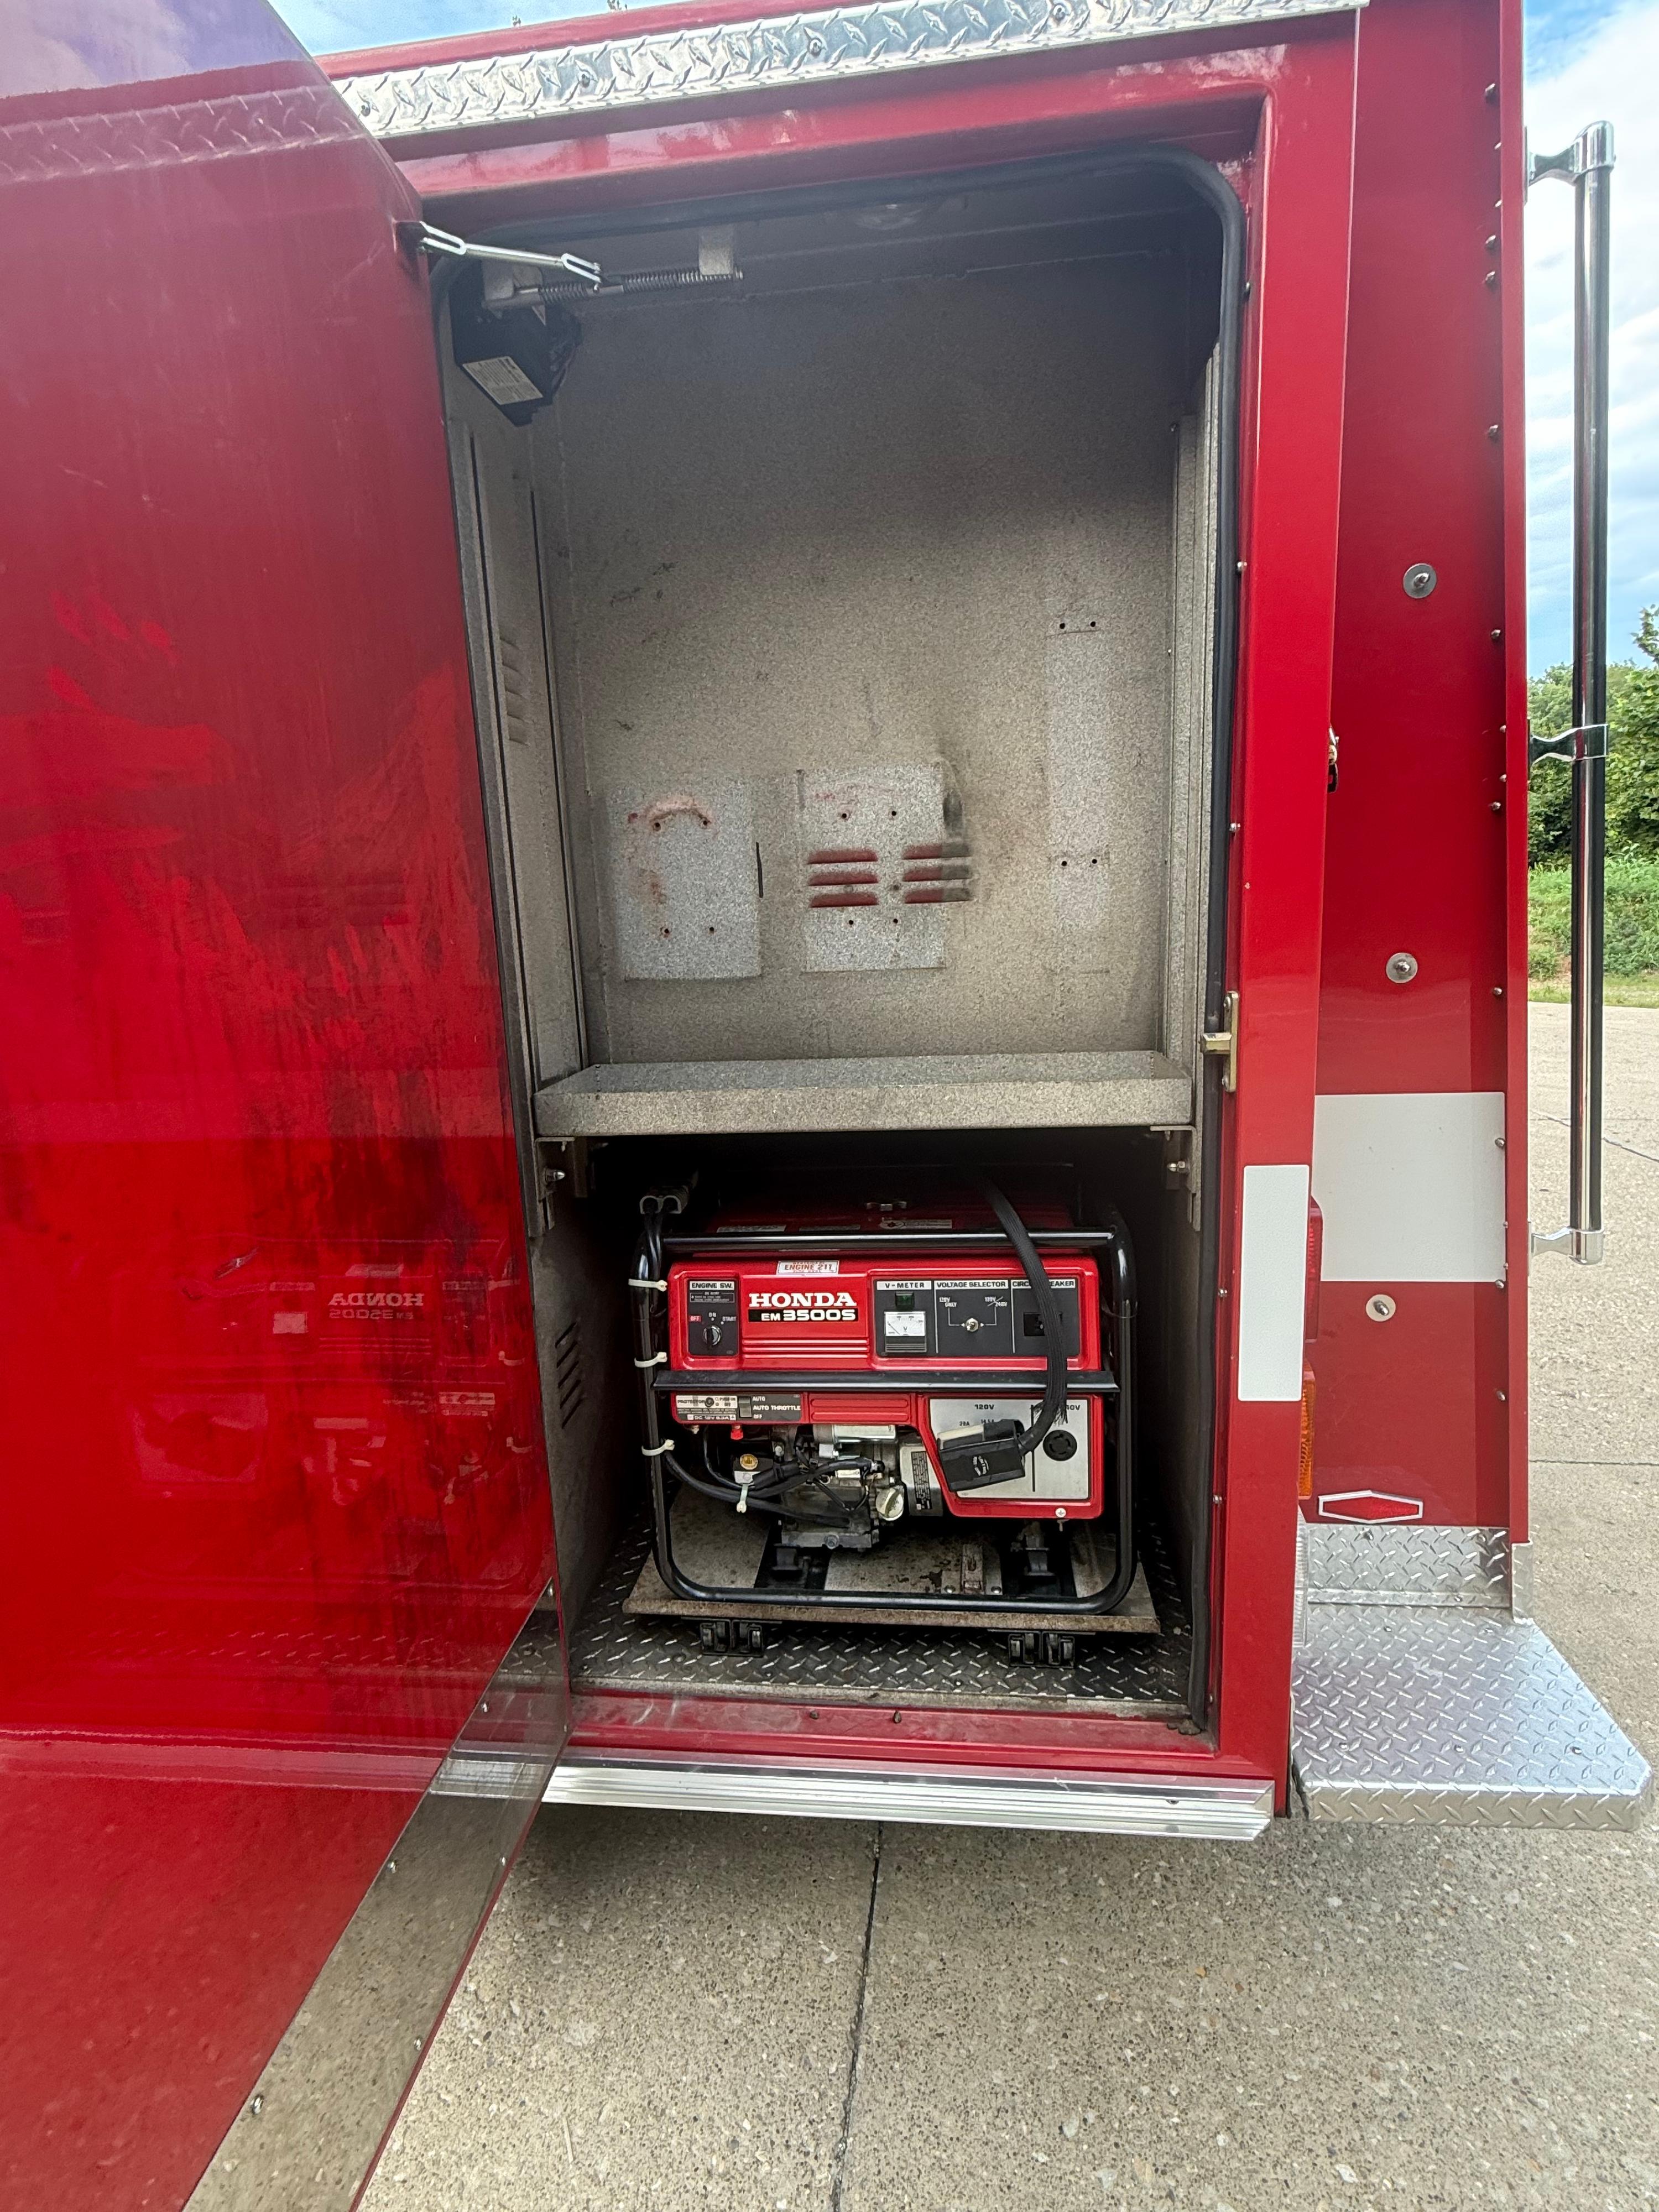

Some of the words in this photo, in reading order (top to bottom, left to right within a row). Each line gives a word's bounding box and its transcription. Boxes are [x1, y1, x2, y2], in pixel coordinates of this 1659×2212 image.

[749, 1292, 857, 1308] HONDA
[761, 1313, 781, 1321] EM
[783, 1309, 856, 1321] 3500S
